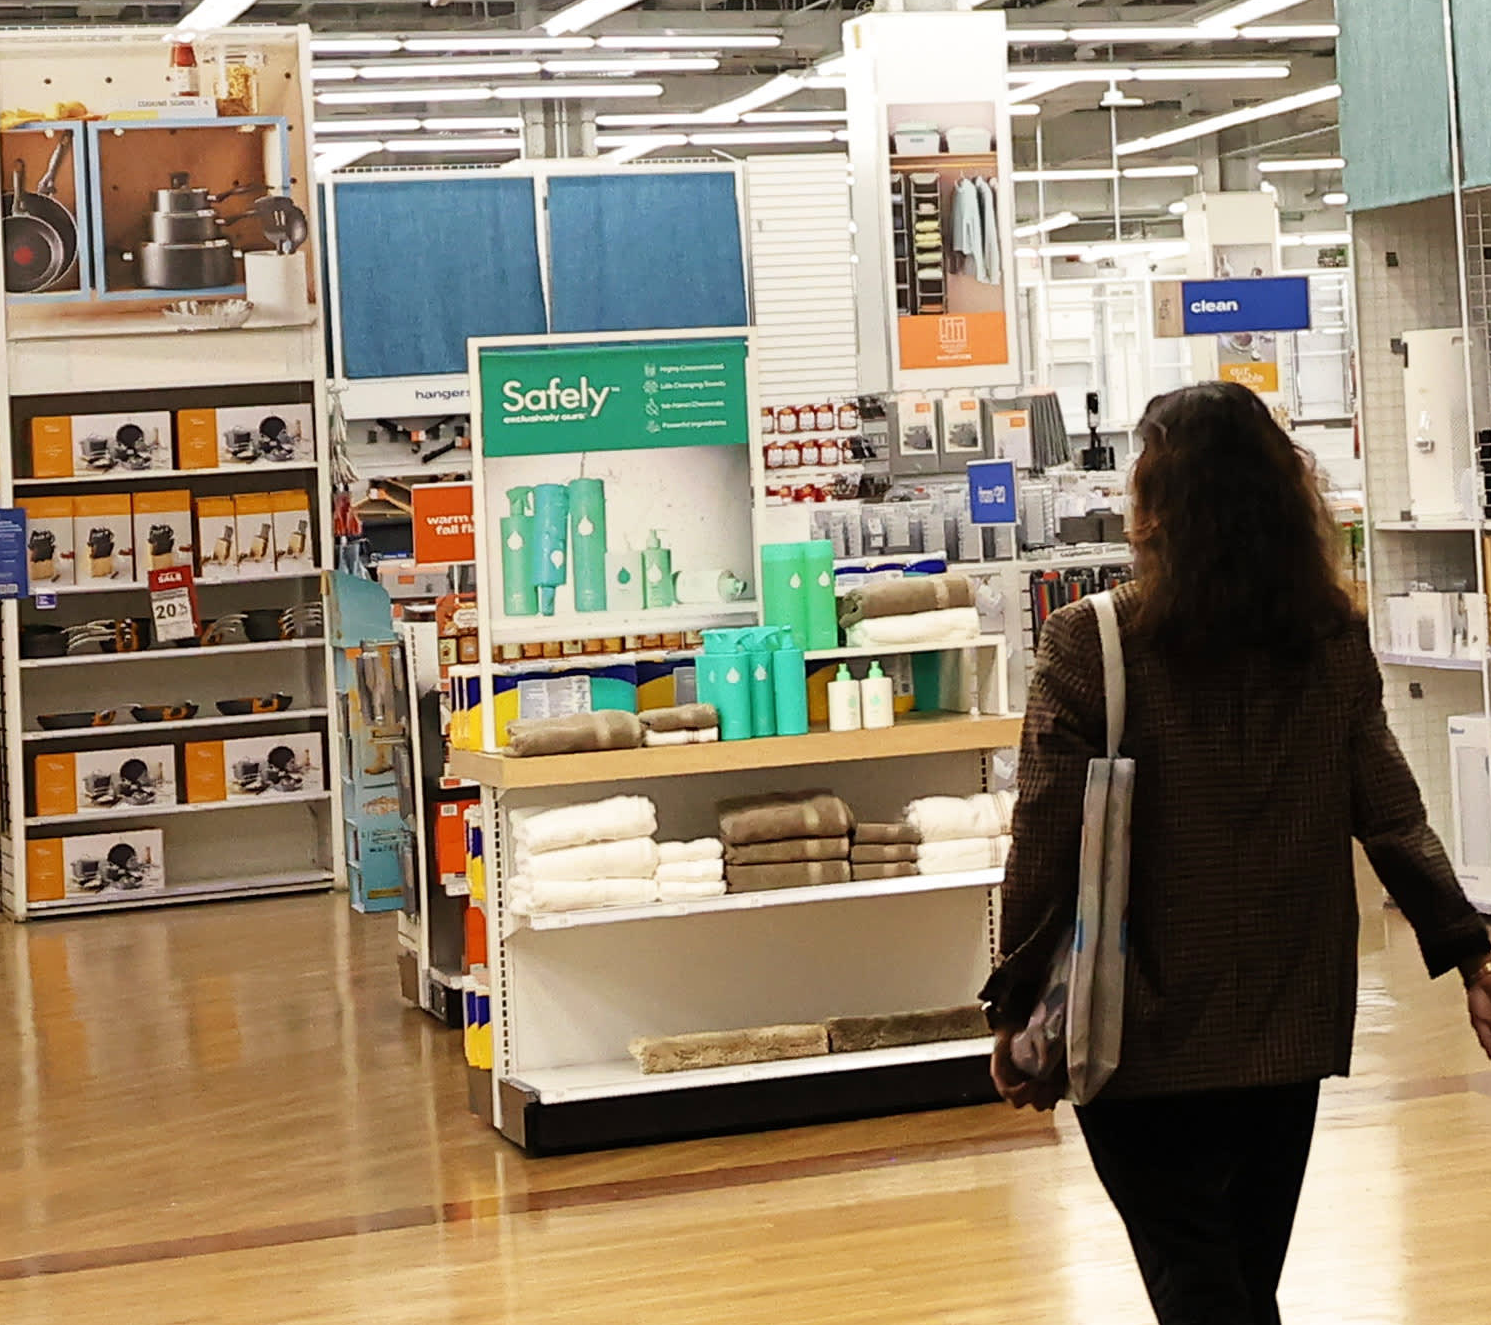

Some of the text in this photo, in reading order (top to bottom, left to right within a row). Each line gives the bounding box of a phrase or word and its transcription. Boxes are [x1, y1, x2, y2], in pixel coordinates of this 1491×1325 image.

[1190, 299, 1239, 314] clean
[414, 389, 471, 401] hangers
[502, 376, 611, 418] Safely
[427, 514, 469, 526] warm
[436, 523, 460, 536] fall
